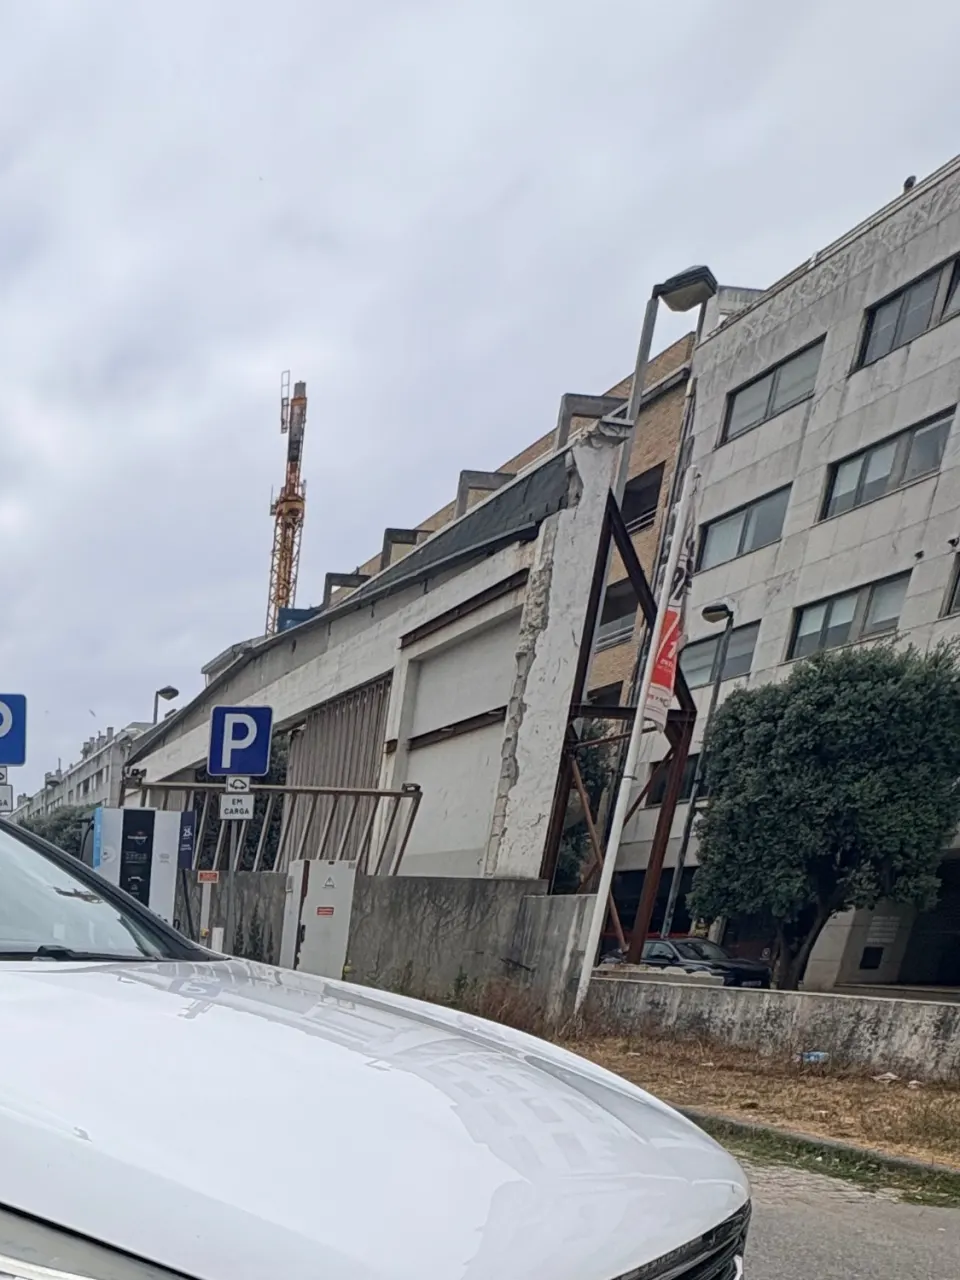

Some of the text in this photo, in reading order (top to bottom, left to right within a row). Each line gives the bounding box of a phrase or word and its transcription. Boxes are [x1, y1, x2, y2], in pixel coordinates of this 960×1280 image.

[221, 713, 257, 768] P
[232, 798, 244, 807] EM
[224, 807, 250, 816] CARGA
